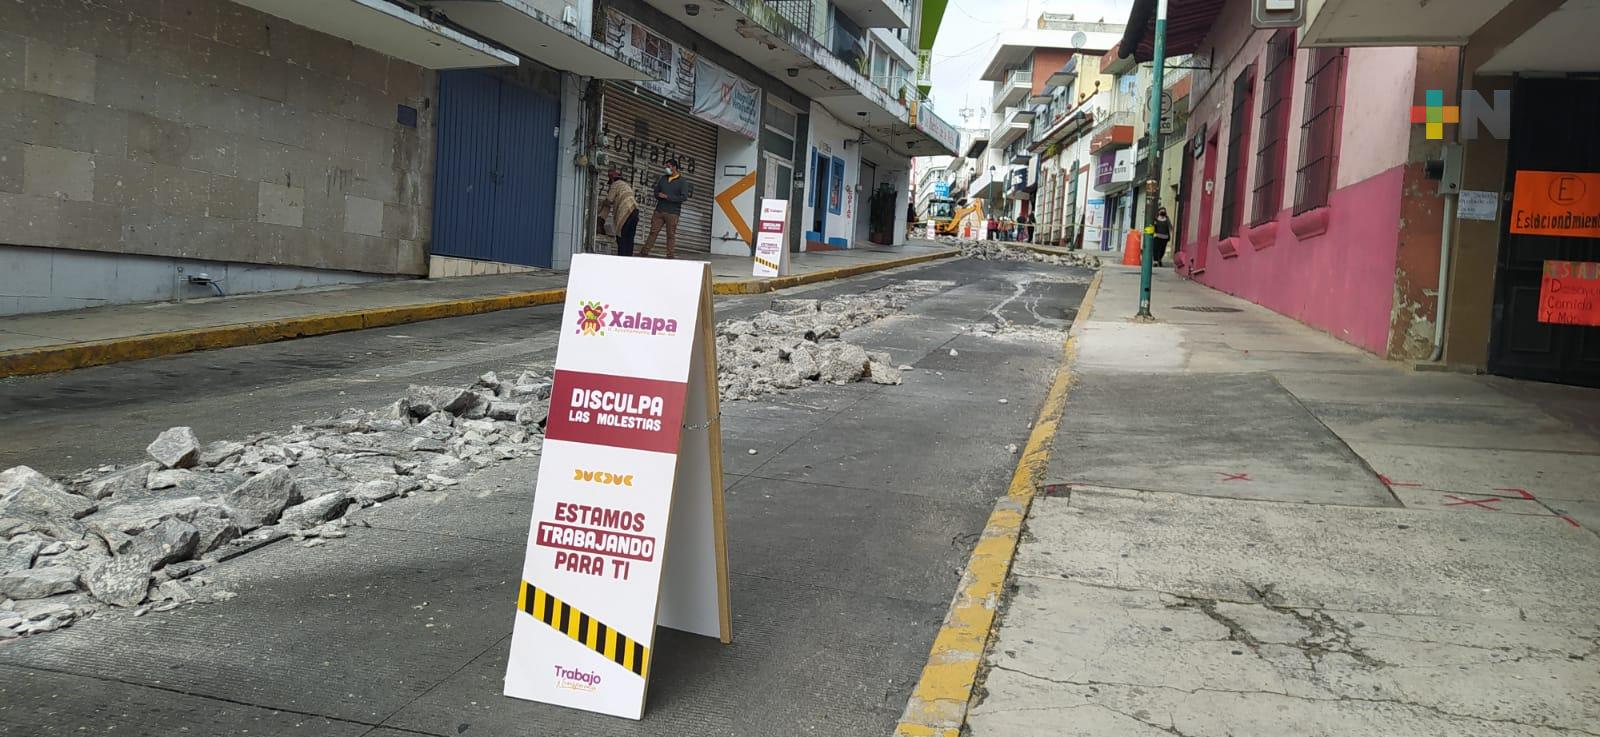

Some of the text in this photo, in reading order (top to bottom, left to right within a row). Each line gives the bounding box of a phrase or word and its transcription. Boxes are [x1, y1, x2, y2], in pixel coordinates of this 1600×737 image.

[1558, 177, 1576, 202] E
[609, 310, 678, 335] Xalapa
[570, 387, 664, 418] DISCULPA
[568, 409, 662, 432] LAS MOLESTIAS
[554, 501, 646, 532] ESTAMOS
[540, 524, 653, 558] TRABAJANDO
[554, 550, 631, 581] PARA TI
[554, 664, 601, 686] Trabajo
